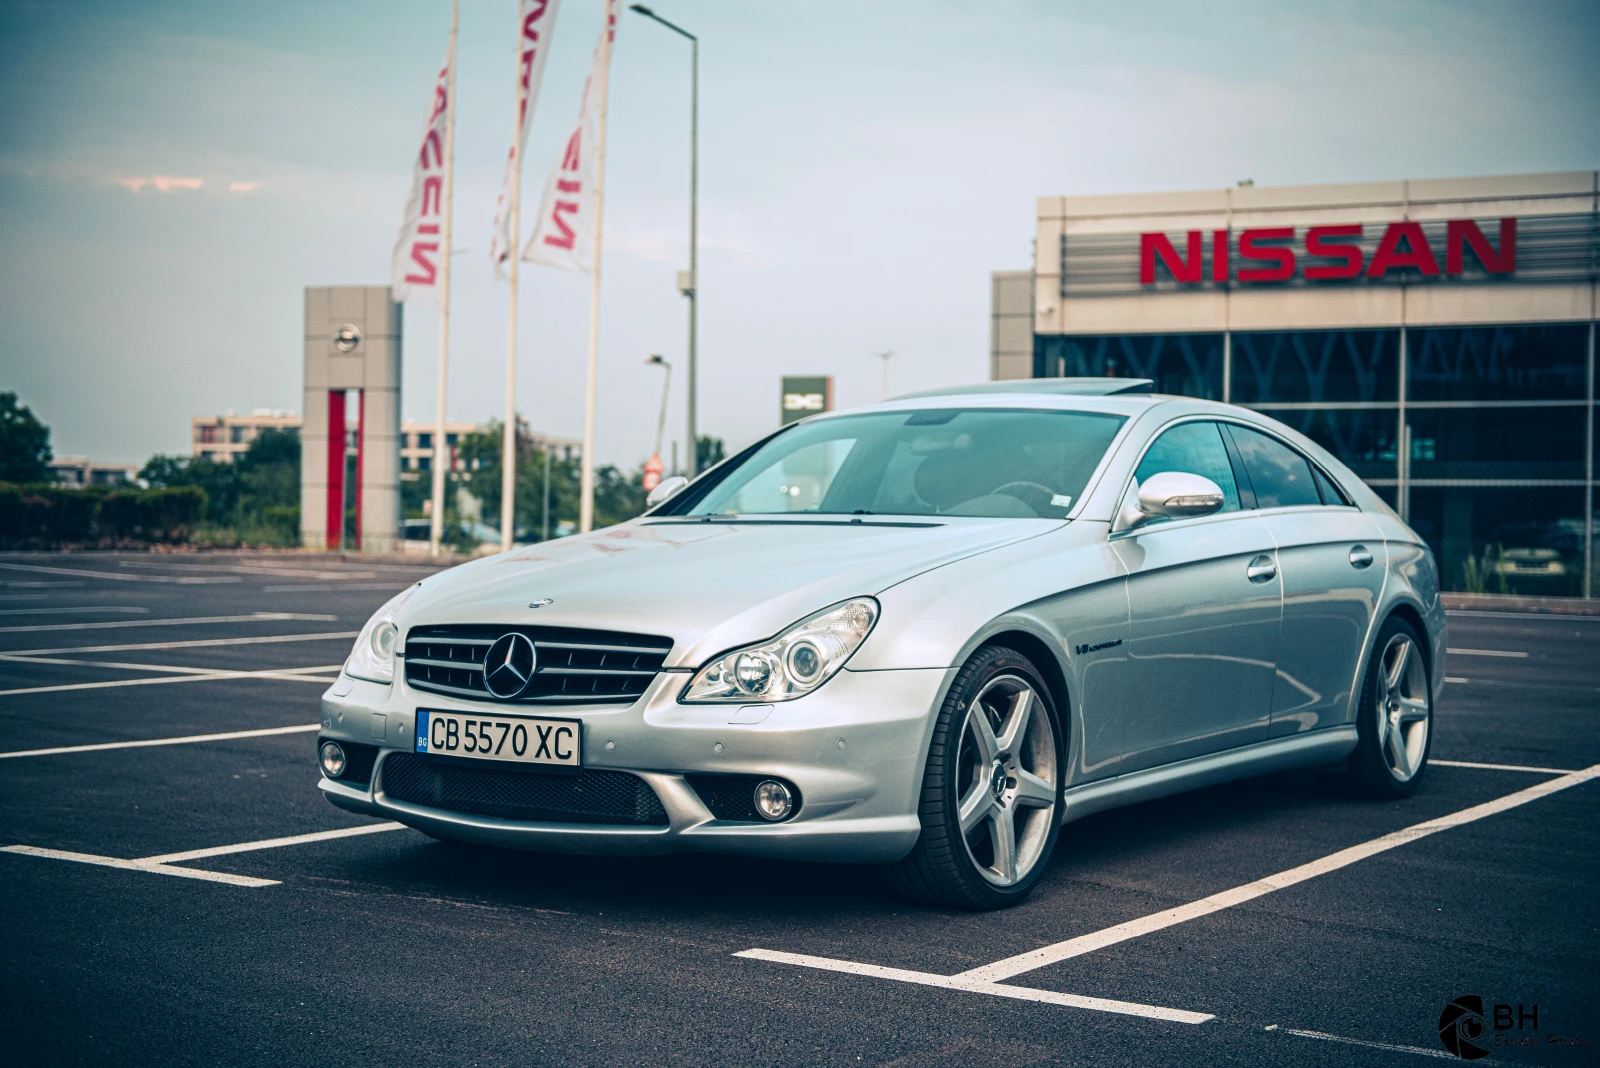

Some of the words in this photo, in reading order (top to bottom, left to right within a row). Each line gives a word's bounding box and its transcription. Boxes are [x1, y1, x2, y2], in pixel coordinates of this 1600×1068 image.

[1139, 217, 1518, 284] NISSAN
[418, 736, 428, 747] BG
[431, 717, 460, 751] CB
[464, 719, 528, 757] 5570
[534, 724, 573, 760] XC
